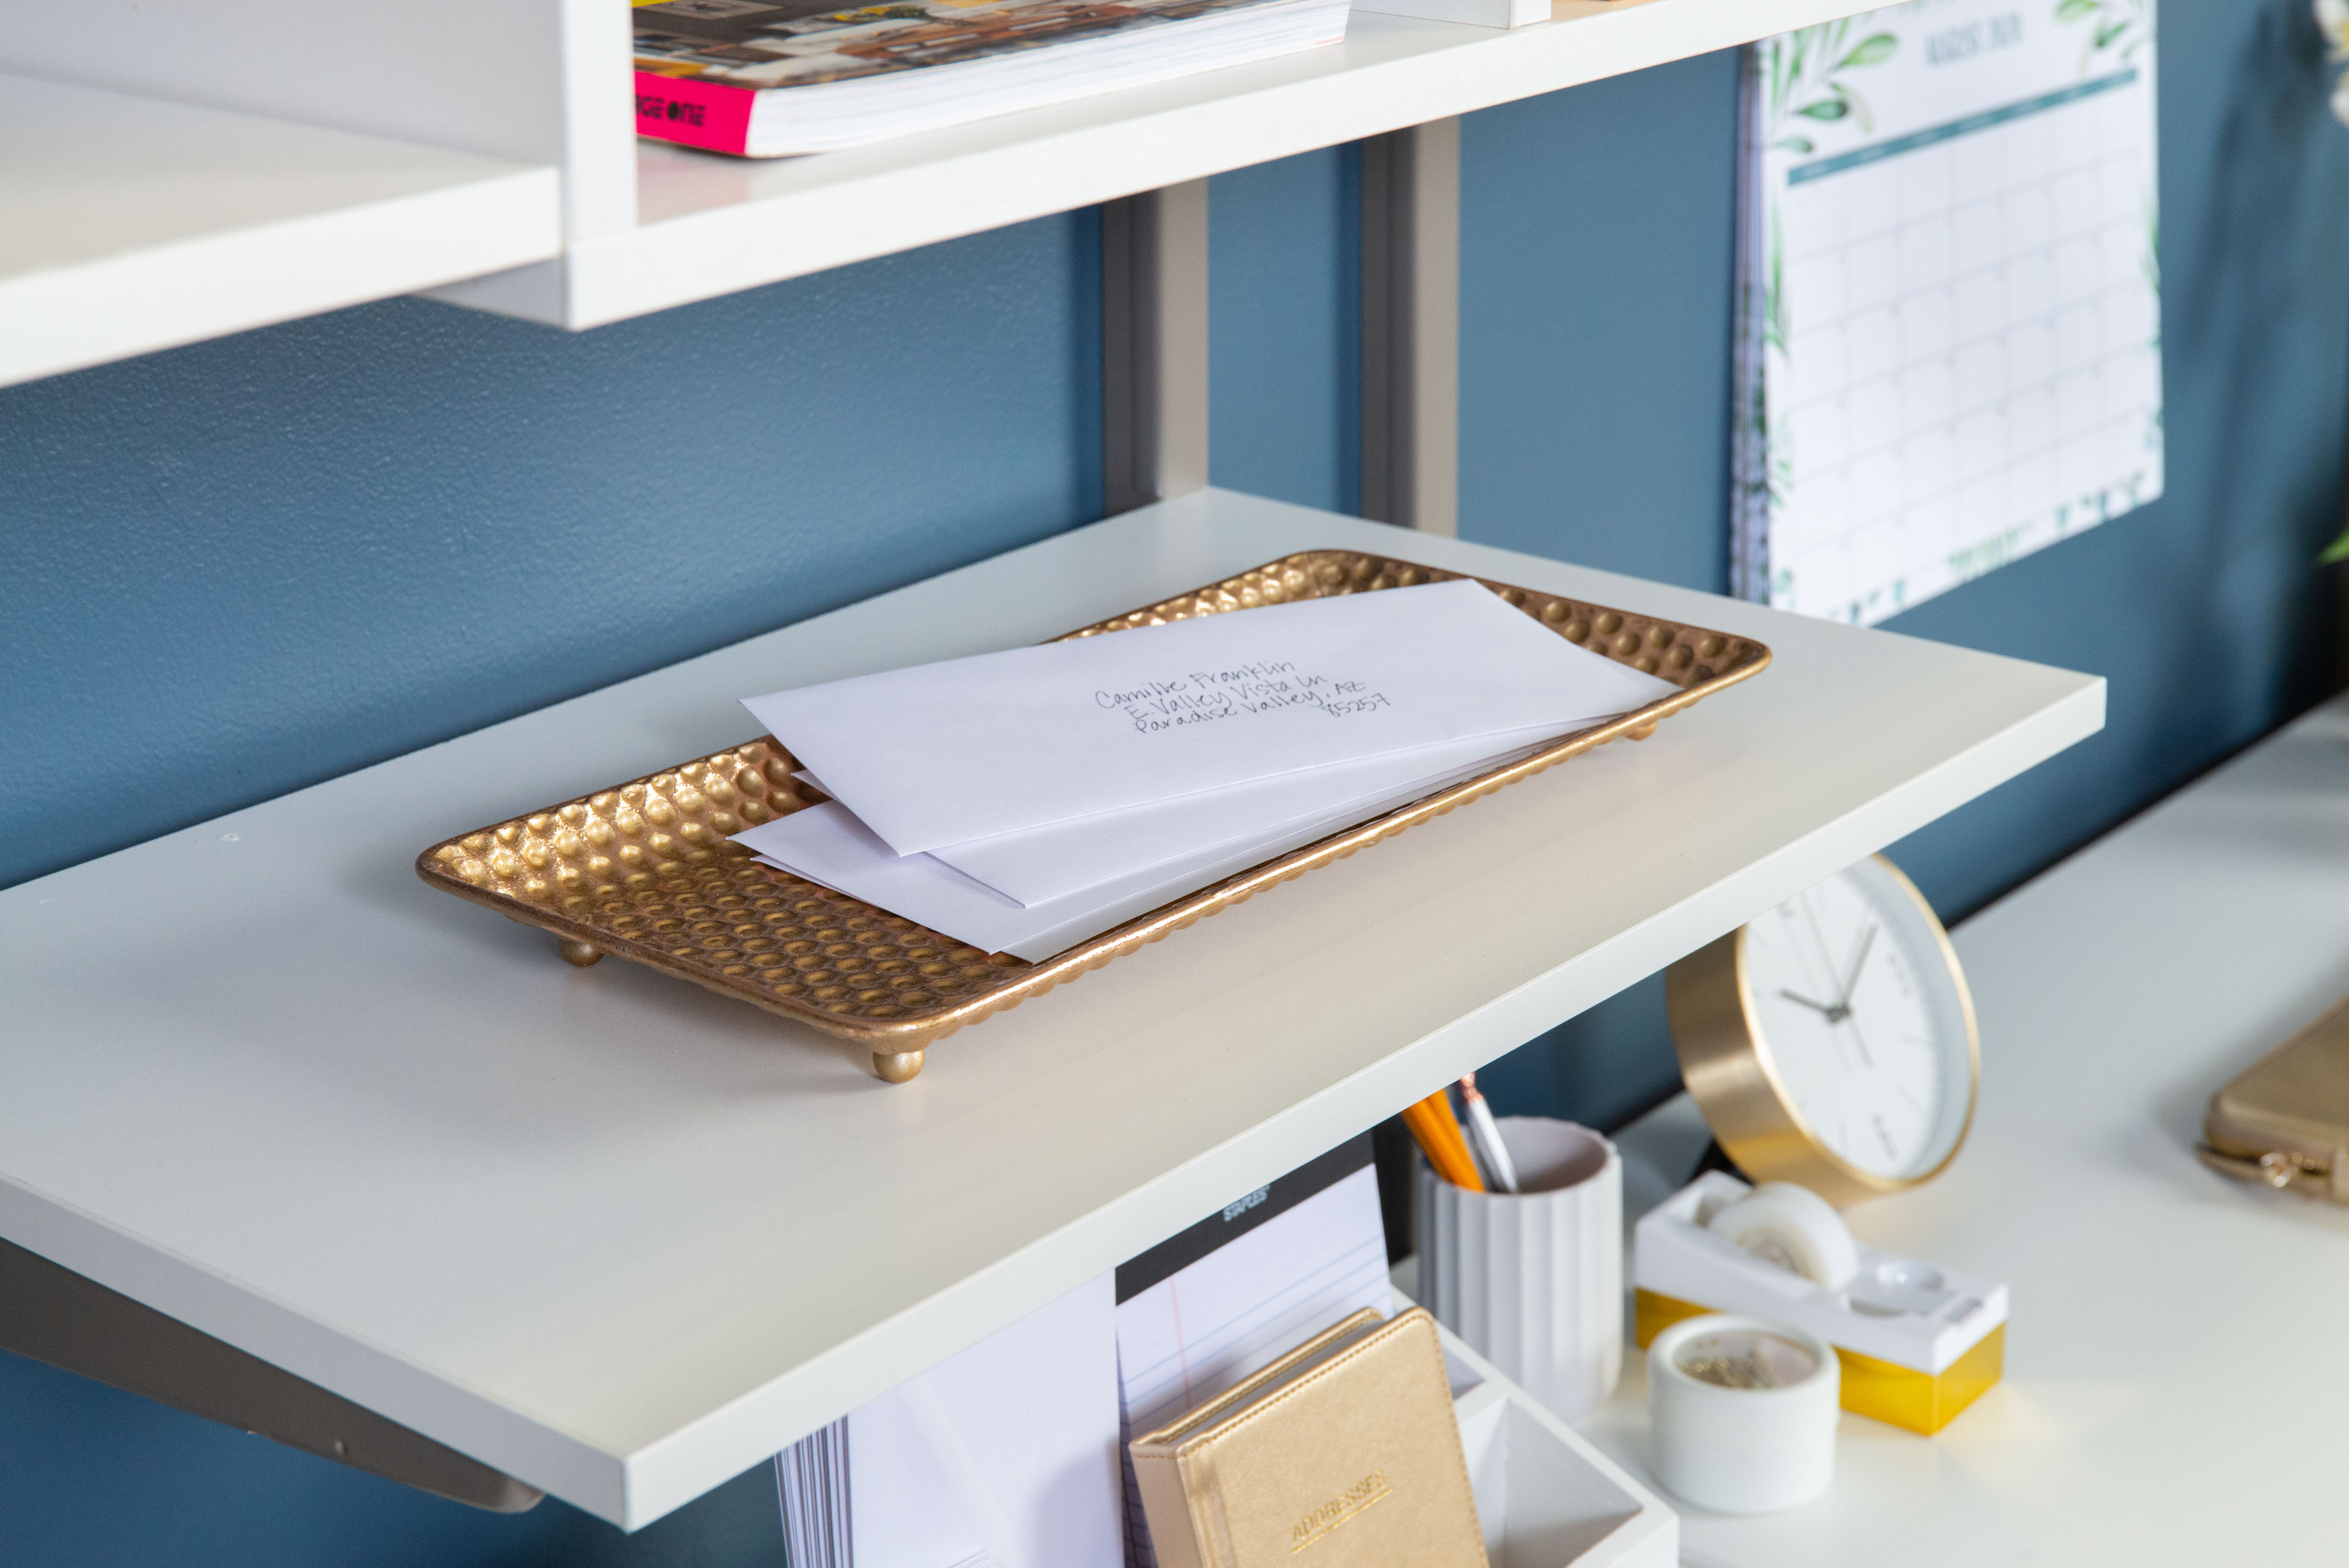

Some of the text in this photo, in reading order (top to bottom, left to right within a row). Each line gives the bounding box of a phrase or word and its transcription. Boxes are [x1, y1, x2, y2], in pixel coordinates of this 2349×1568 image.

[1096, 661, 1295, 709] Camille Franklin
[1134, 707, 1237, 734] Paradise
[1335, 681, 1367, 695] AZ
[1150, 692, 1232, 715] Valley
[1230, 679, 1293, 699] Vista
[1321, 692, 1391, 717] 85257
[1293, 1469, 1386, 1542] ADDRESSES
